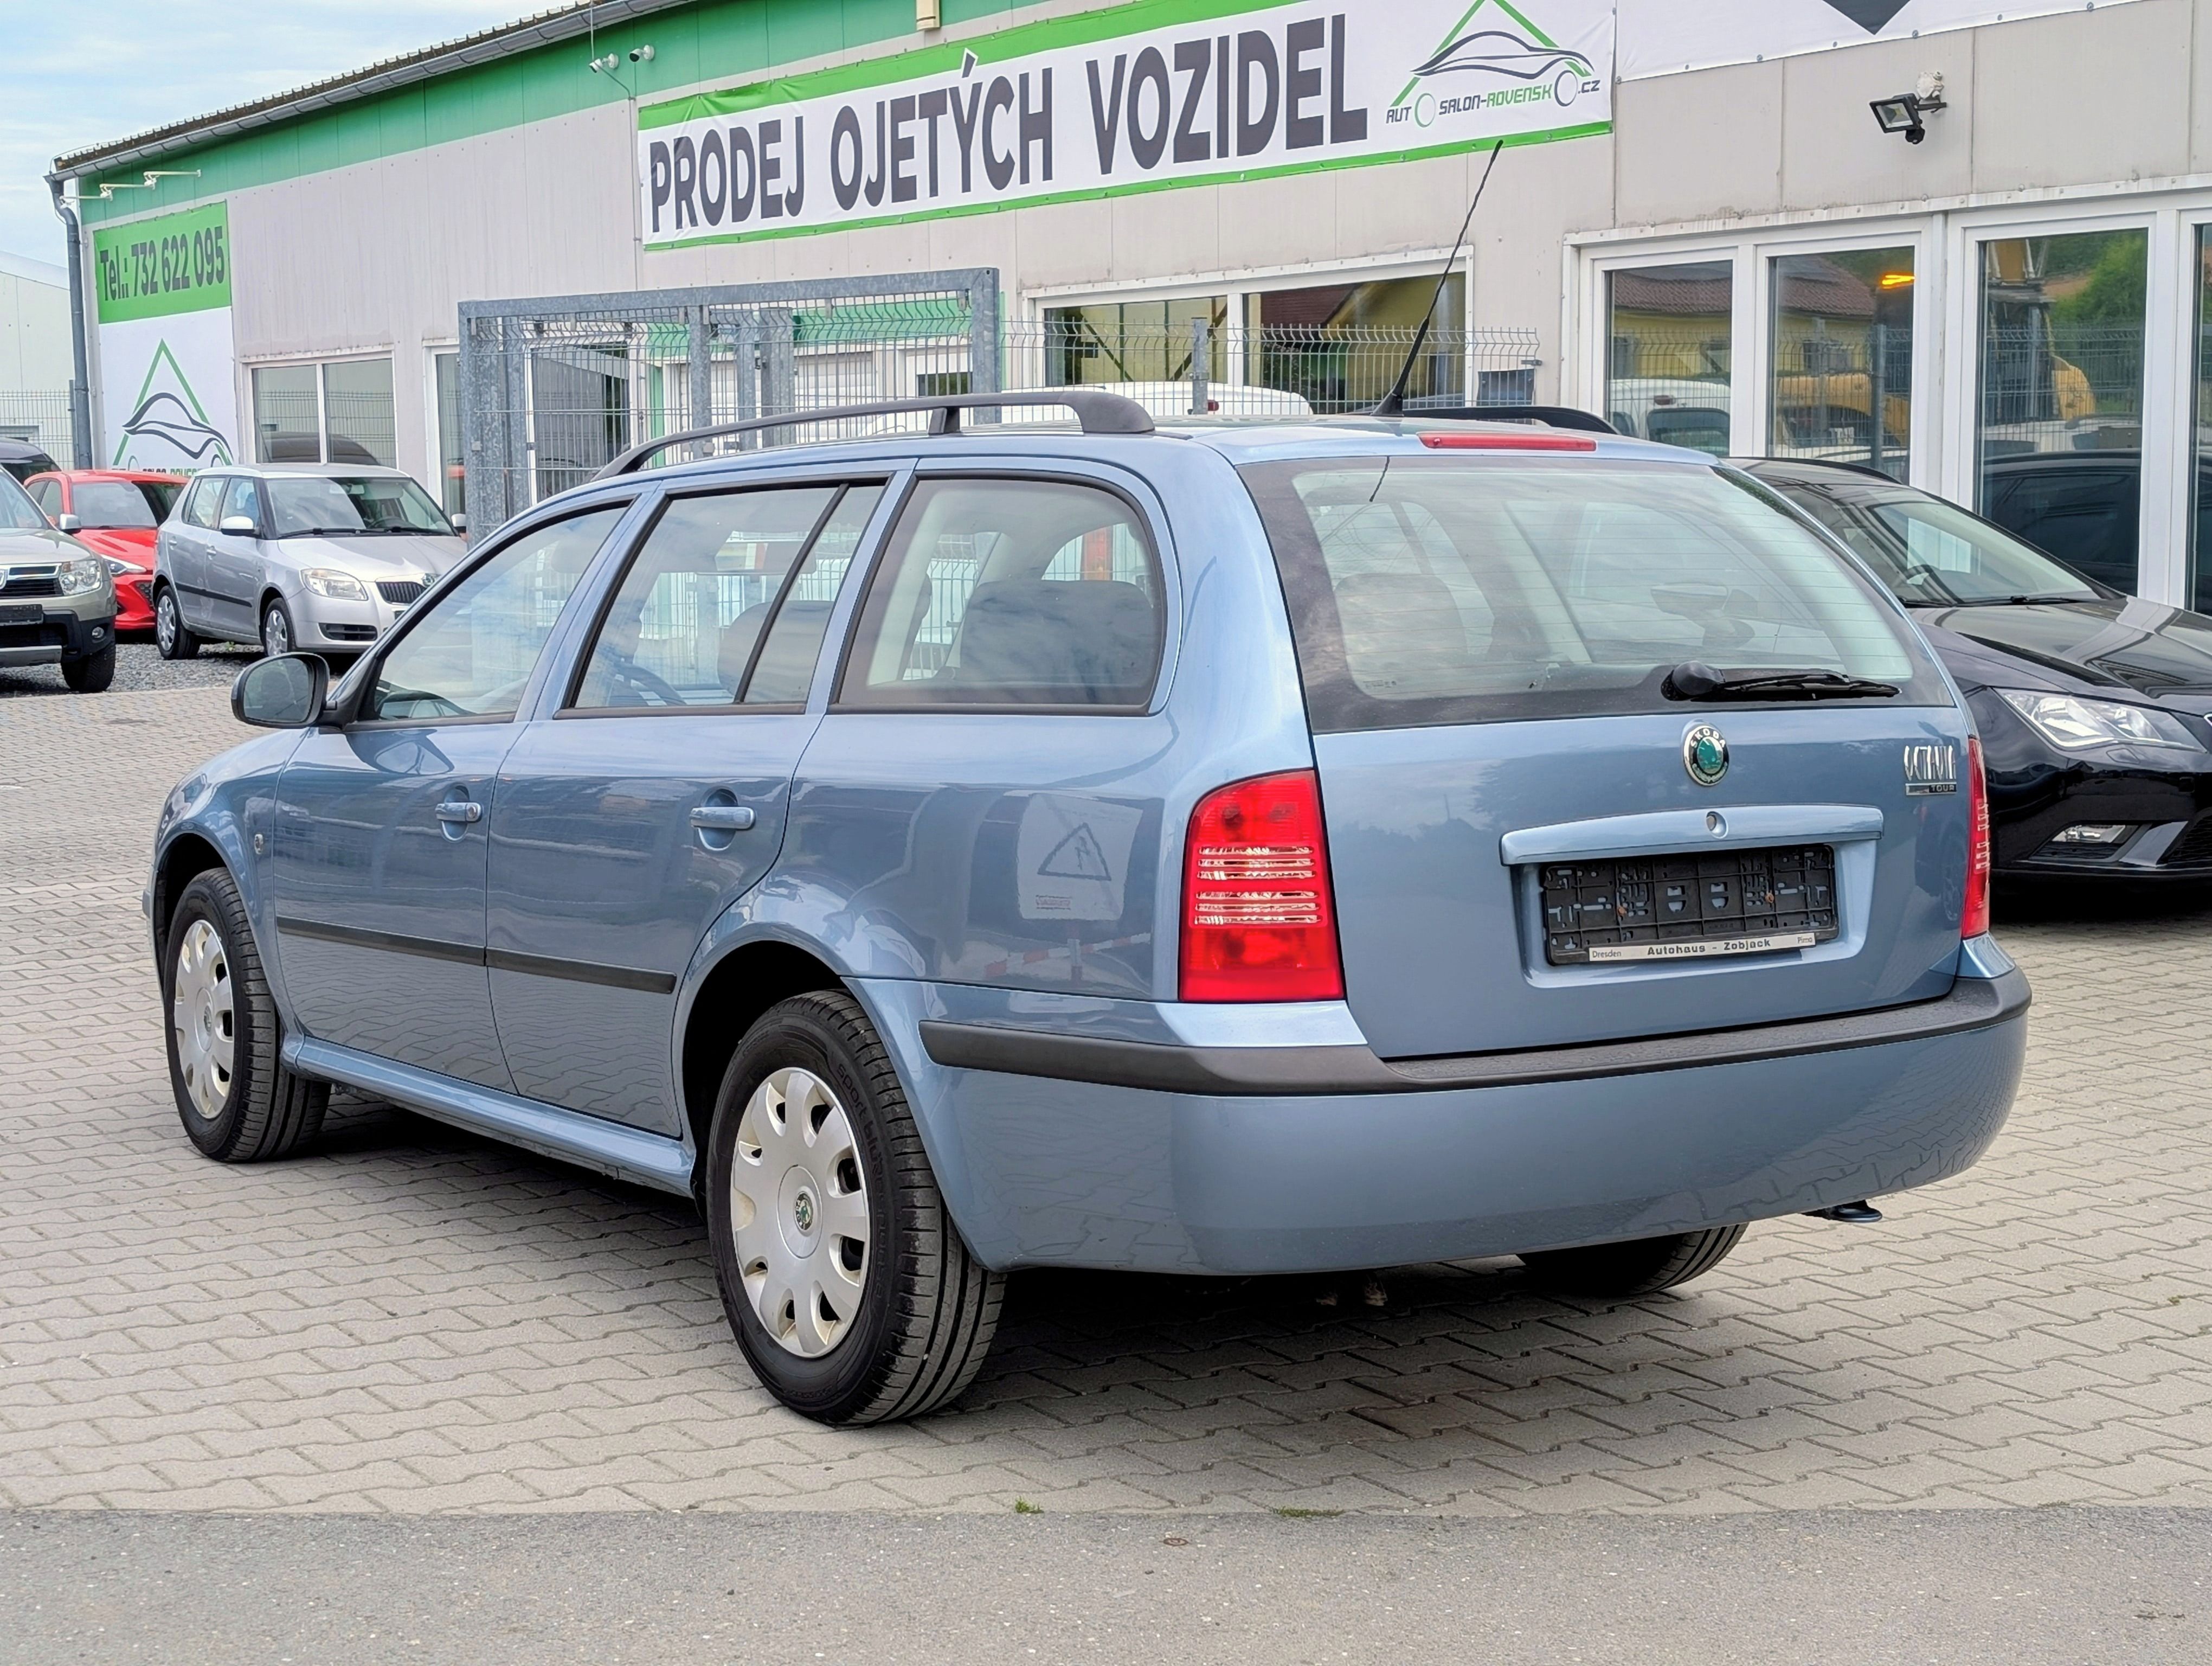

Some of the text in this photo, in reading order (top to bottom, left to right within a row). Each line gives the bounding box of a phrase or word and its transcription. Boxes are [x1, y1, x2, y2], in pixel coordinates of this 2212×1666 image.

[650, 13, 1368, 233] PRODEJ OJETÝCH VOZIDEL
[100, 226, 224, 302] Tel.: 732 622 095
[1592, 949, 1622, 958] Dresden
[1648, 945, 1706, 956] Autohaus
[1724, 939, 1771, 951] Zobjack
